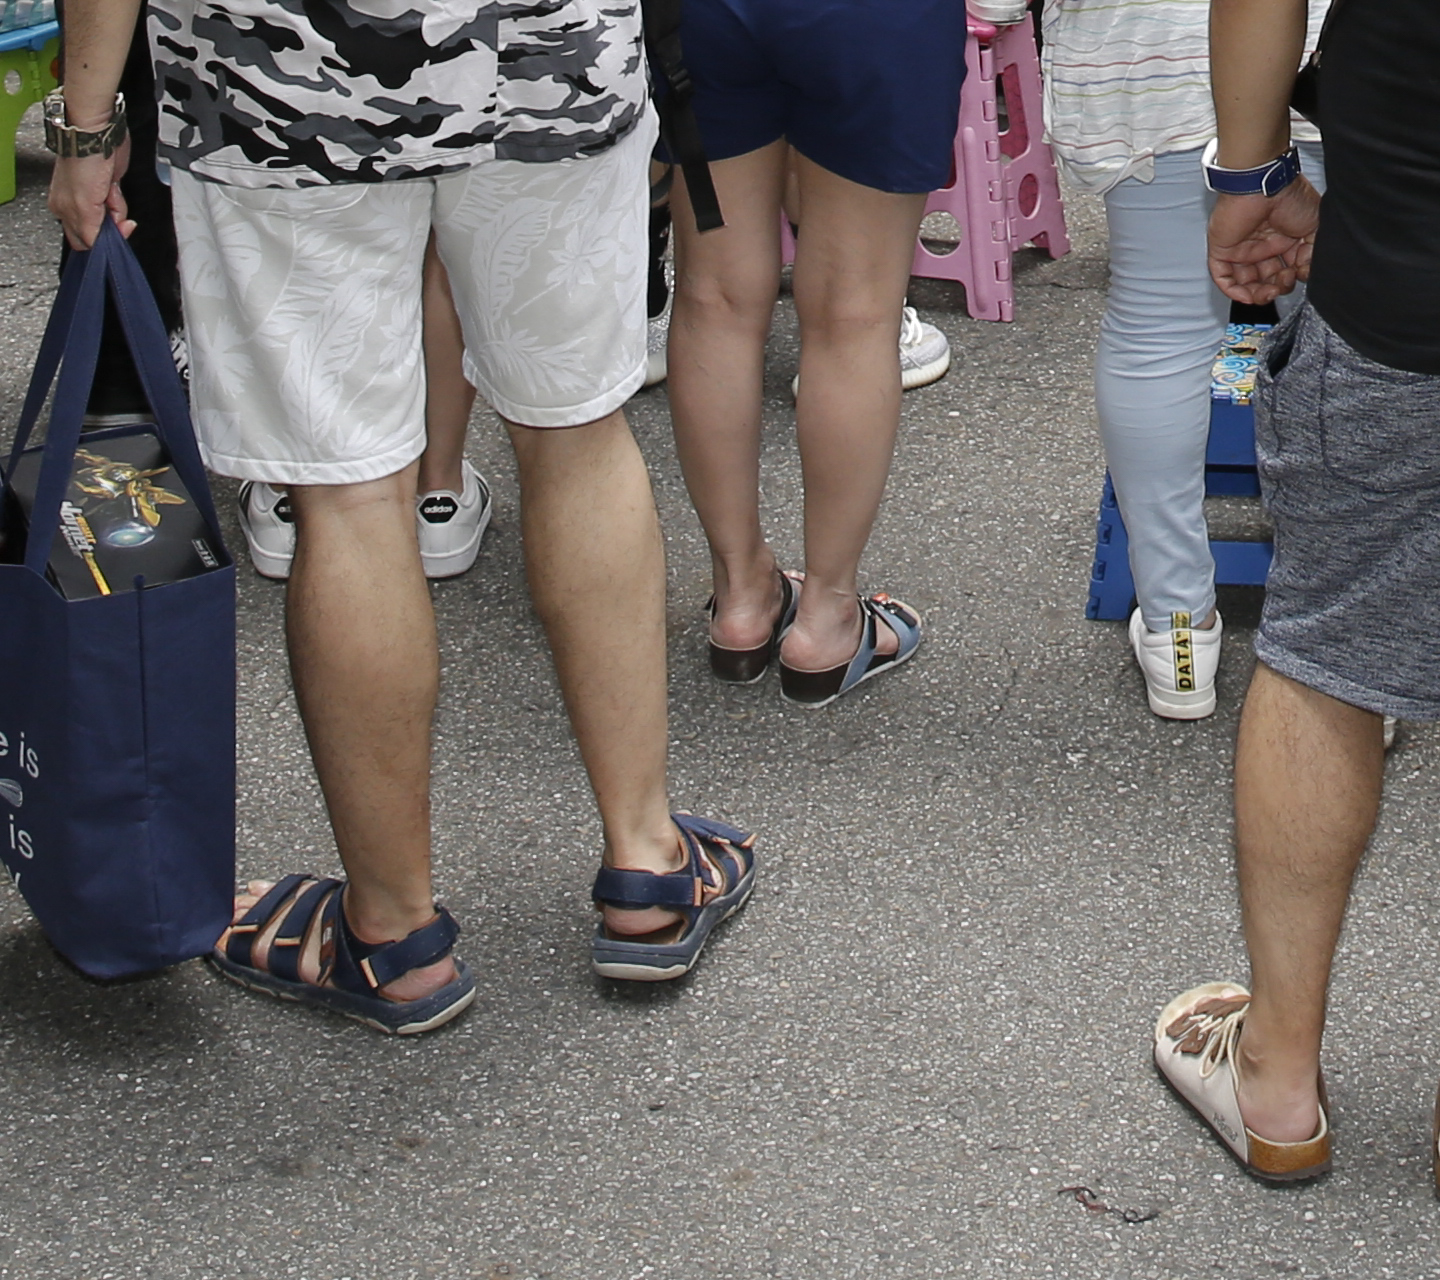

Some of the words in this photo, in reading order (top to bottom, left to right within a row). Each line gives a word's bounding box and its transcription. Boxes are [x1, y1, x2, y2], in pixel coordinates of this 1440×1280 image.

[424, 505, 453, 514] adidas
[1176, 638, 1192, 689] DATA
[19, 731, 40, 779] is
[9, 813, 34, 860] is
